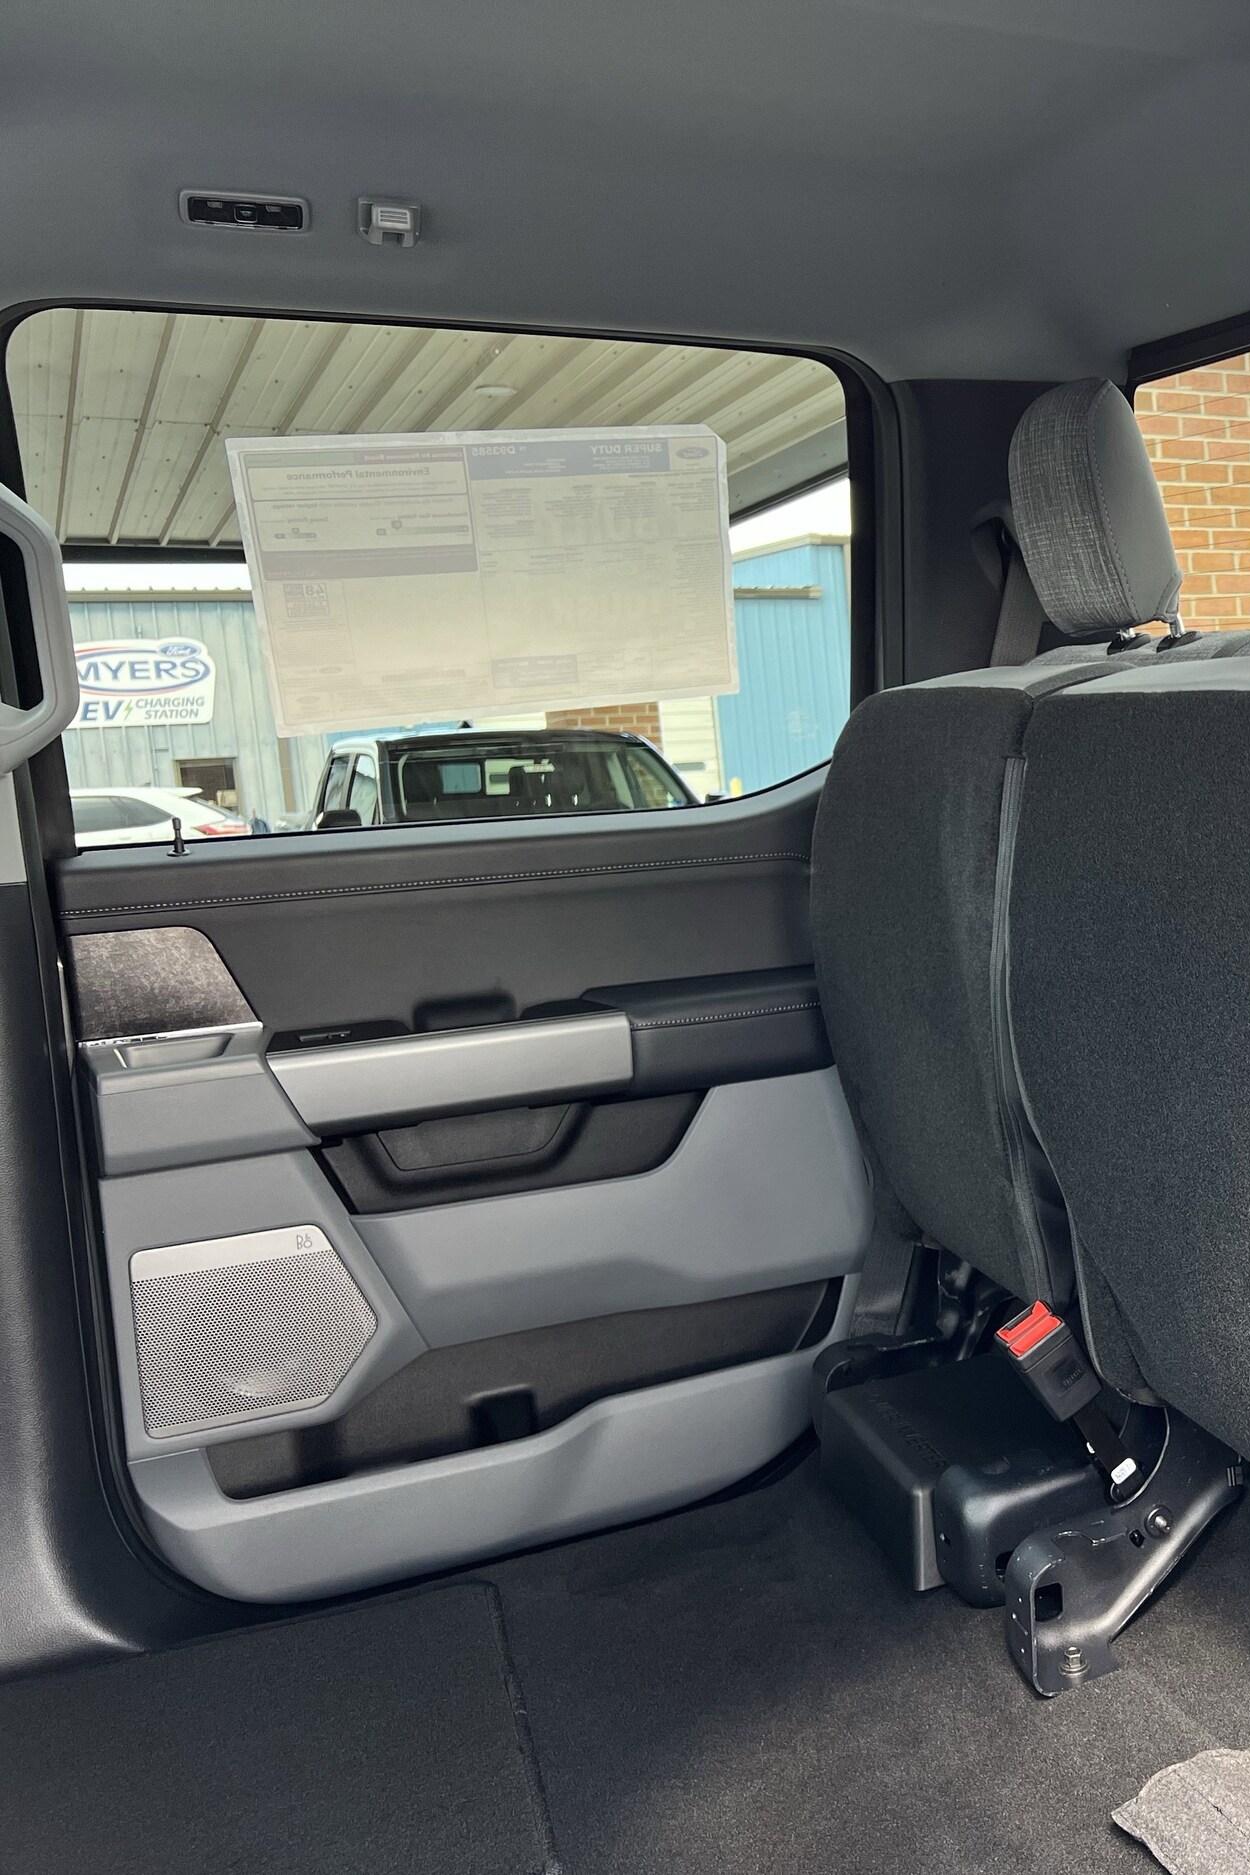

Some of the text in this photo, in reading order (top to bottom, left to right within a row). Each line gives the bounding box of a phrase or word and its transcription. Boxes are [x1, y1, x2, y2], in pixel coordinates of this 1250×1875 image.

[166, 646, 192, 656] Ford
[77, 660, 201, 681] MYERS
[135, 696, 205, 710] CHARGING
[79, 700, 124, 722] EV
[144, 708, 200, 721] STATION
